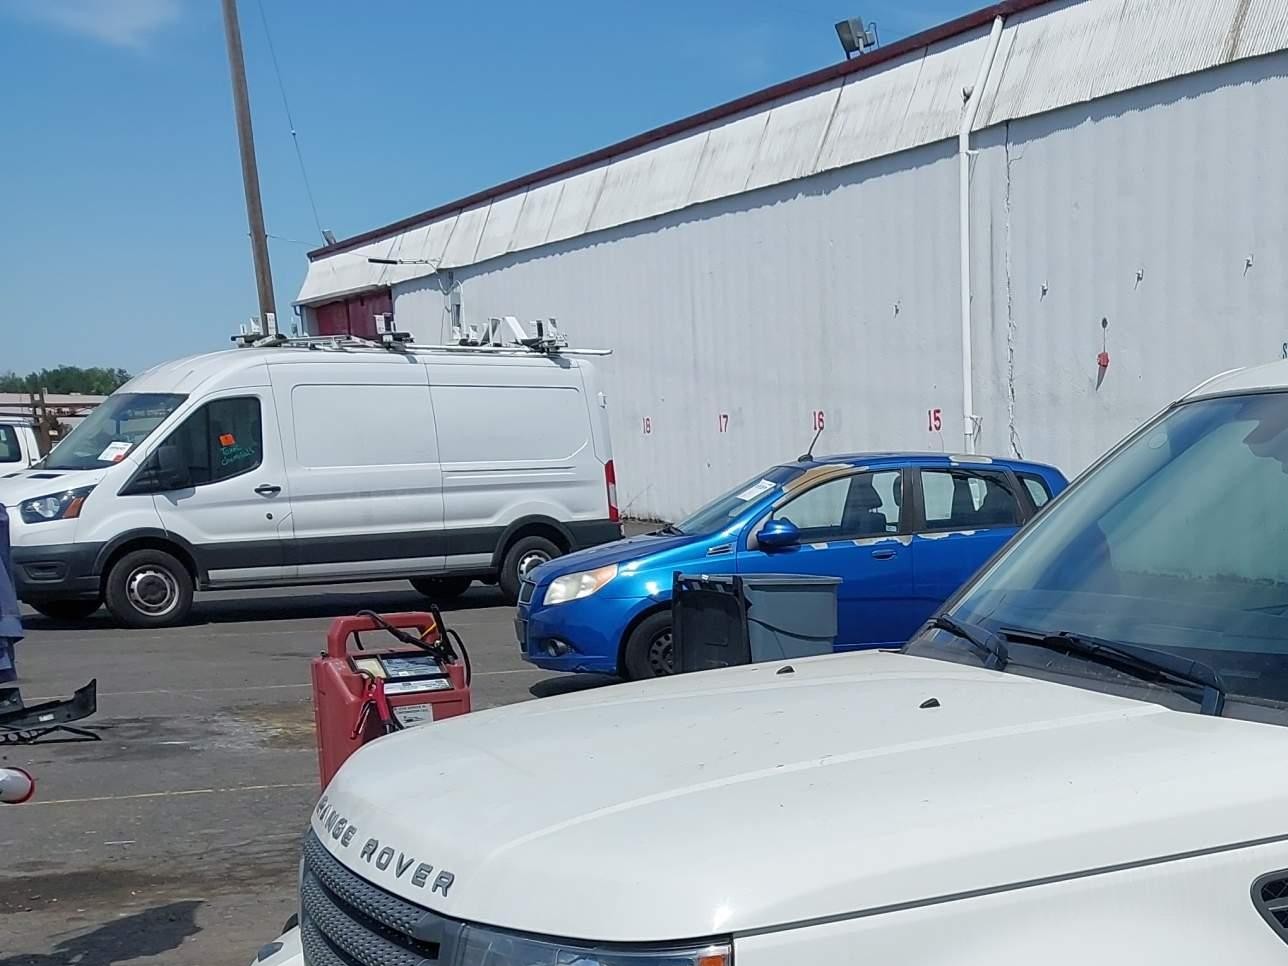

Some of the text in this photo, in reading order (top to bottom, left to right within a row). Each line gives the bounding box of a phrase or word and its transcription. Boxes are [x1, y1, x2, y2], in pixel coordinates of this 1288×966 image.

[642, 417, 651, 434] 18
[719, 414, 729, 433] 17
[813, 410, 825, 431] 16
[928, 409, 942, 432] 15
[316, 795, 456, 898] RANGE ROVER
